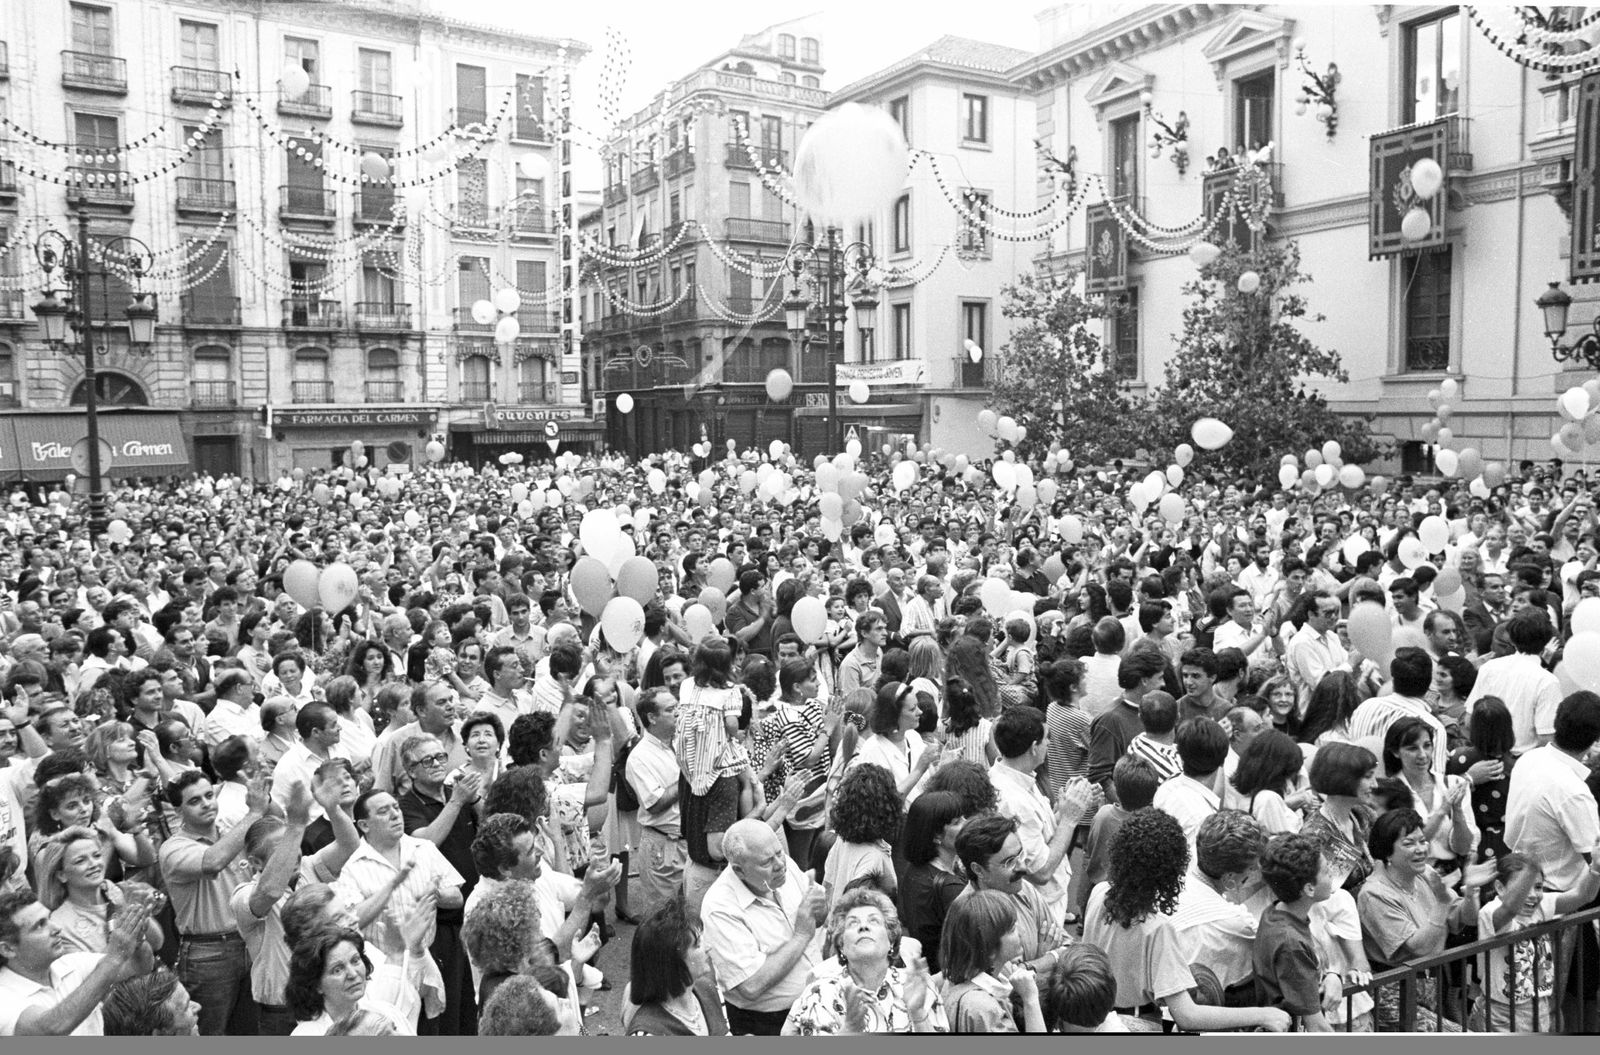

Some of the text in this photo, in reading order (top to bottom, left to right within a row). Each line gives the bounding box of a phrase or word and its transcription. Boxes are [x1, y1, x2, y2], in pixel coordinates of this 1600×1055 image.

[292, 413, 419, 424] FARMACIA DEL CARMEN
[122, 440, 174, 457] Carmen
